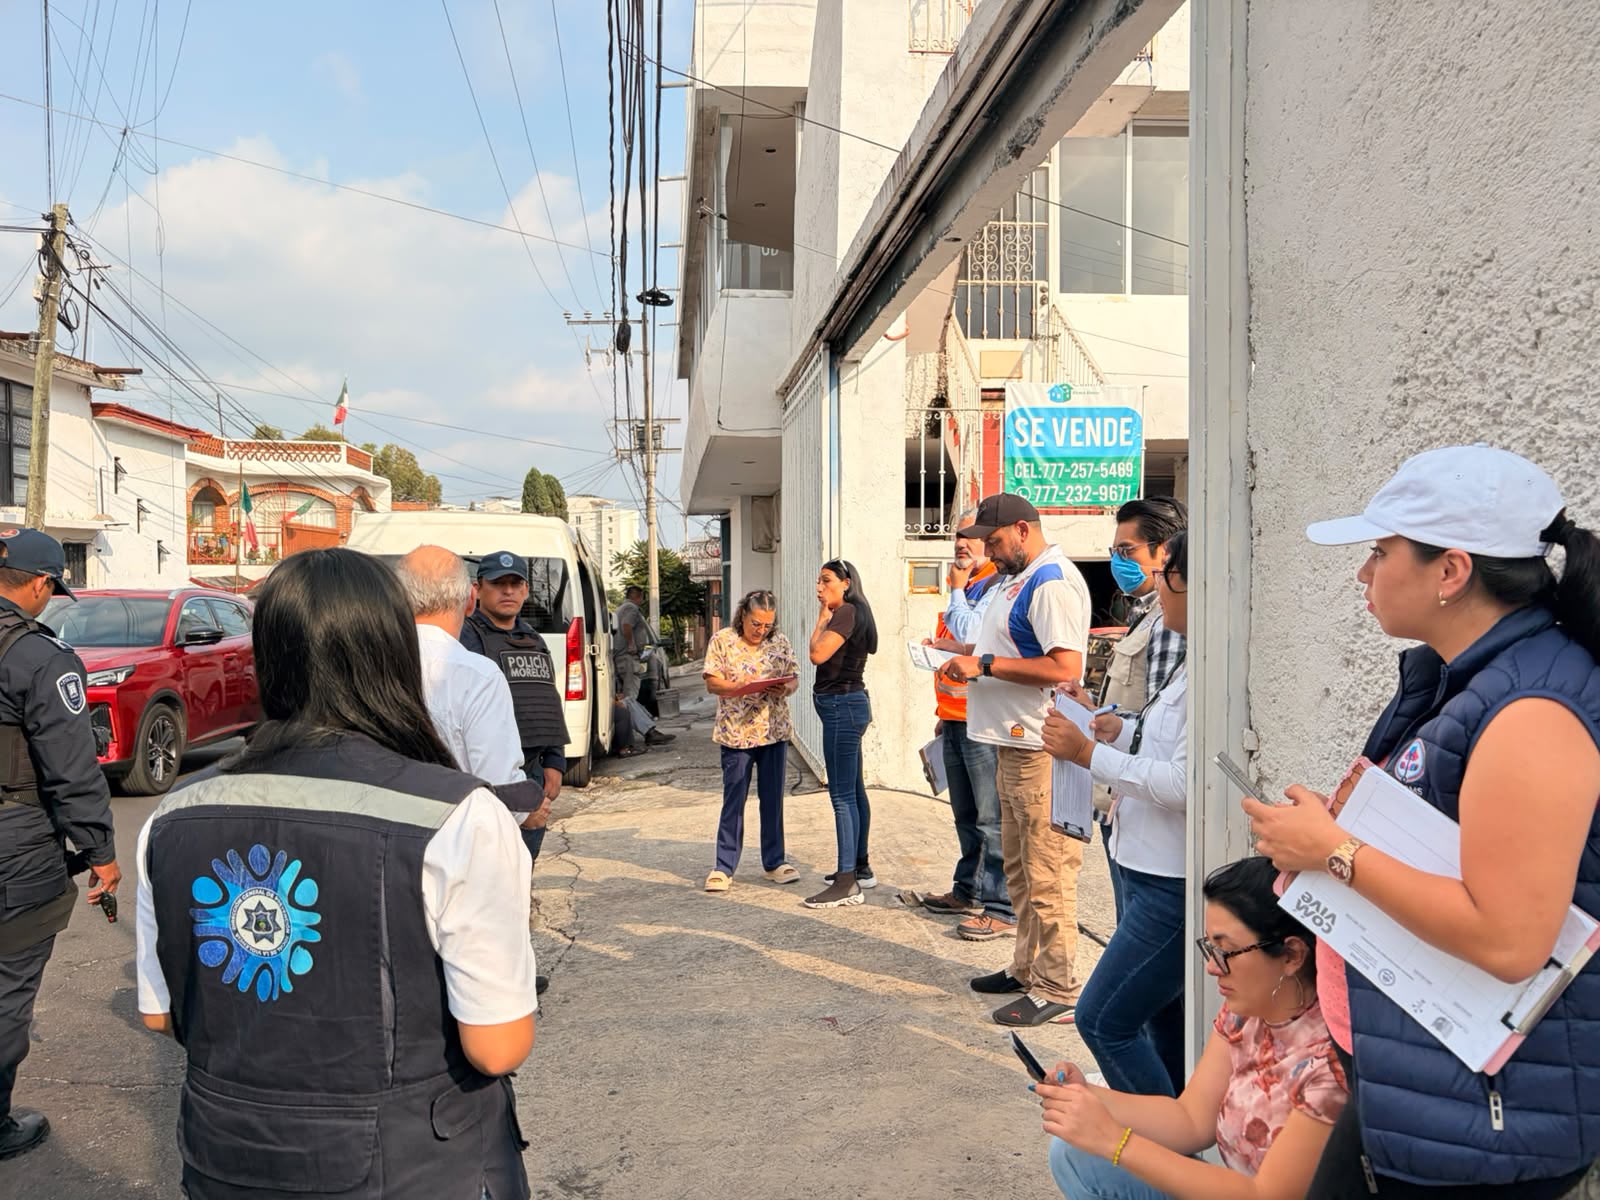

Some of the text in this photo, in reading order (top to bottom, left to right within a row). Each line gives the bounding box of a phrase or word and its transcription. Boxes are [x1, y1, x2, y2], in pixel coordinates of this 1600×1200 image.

[1014, 416, 1133, 447] SE VENDE
[1034, 484, 1131, 502] 777-232-9671
[507, 654, 549, 672] POLICÍA
[511, 667, 550, 679] MORELOS
